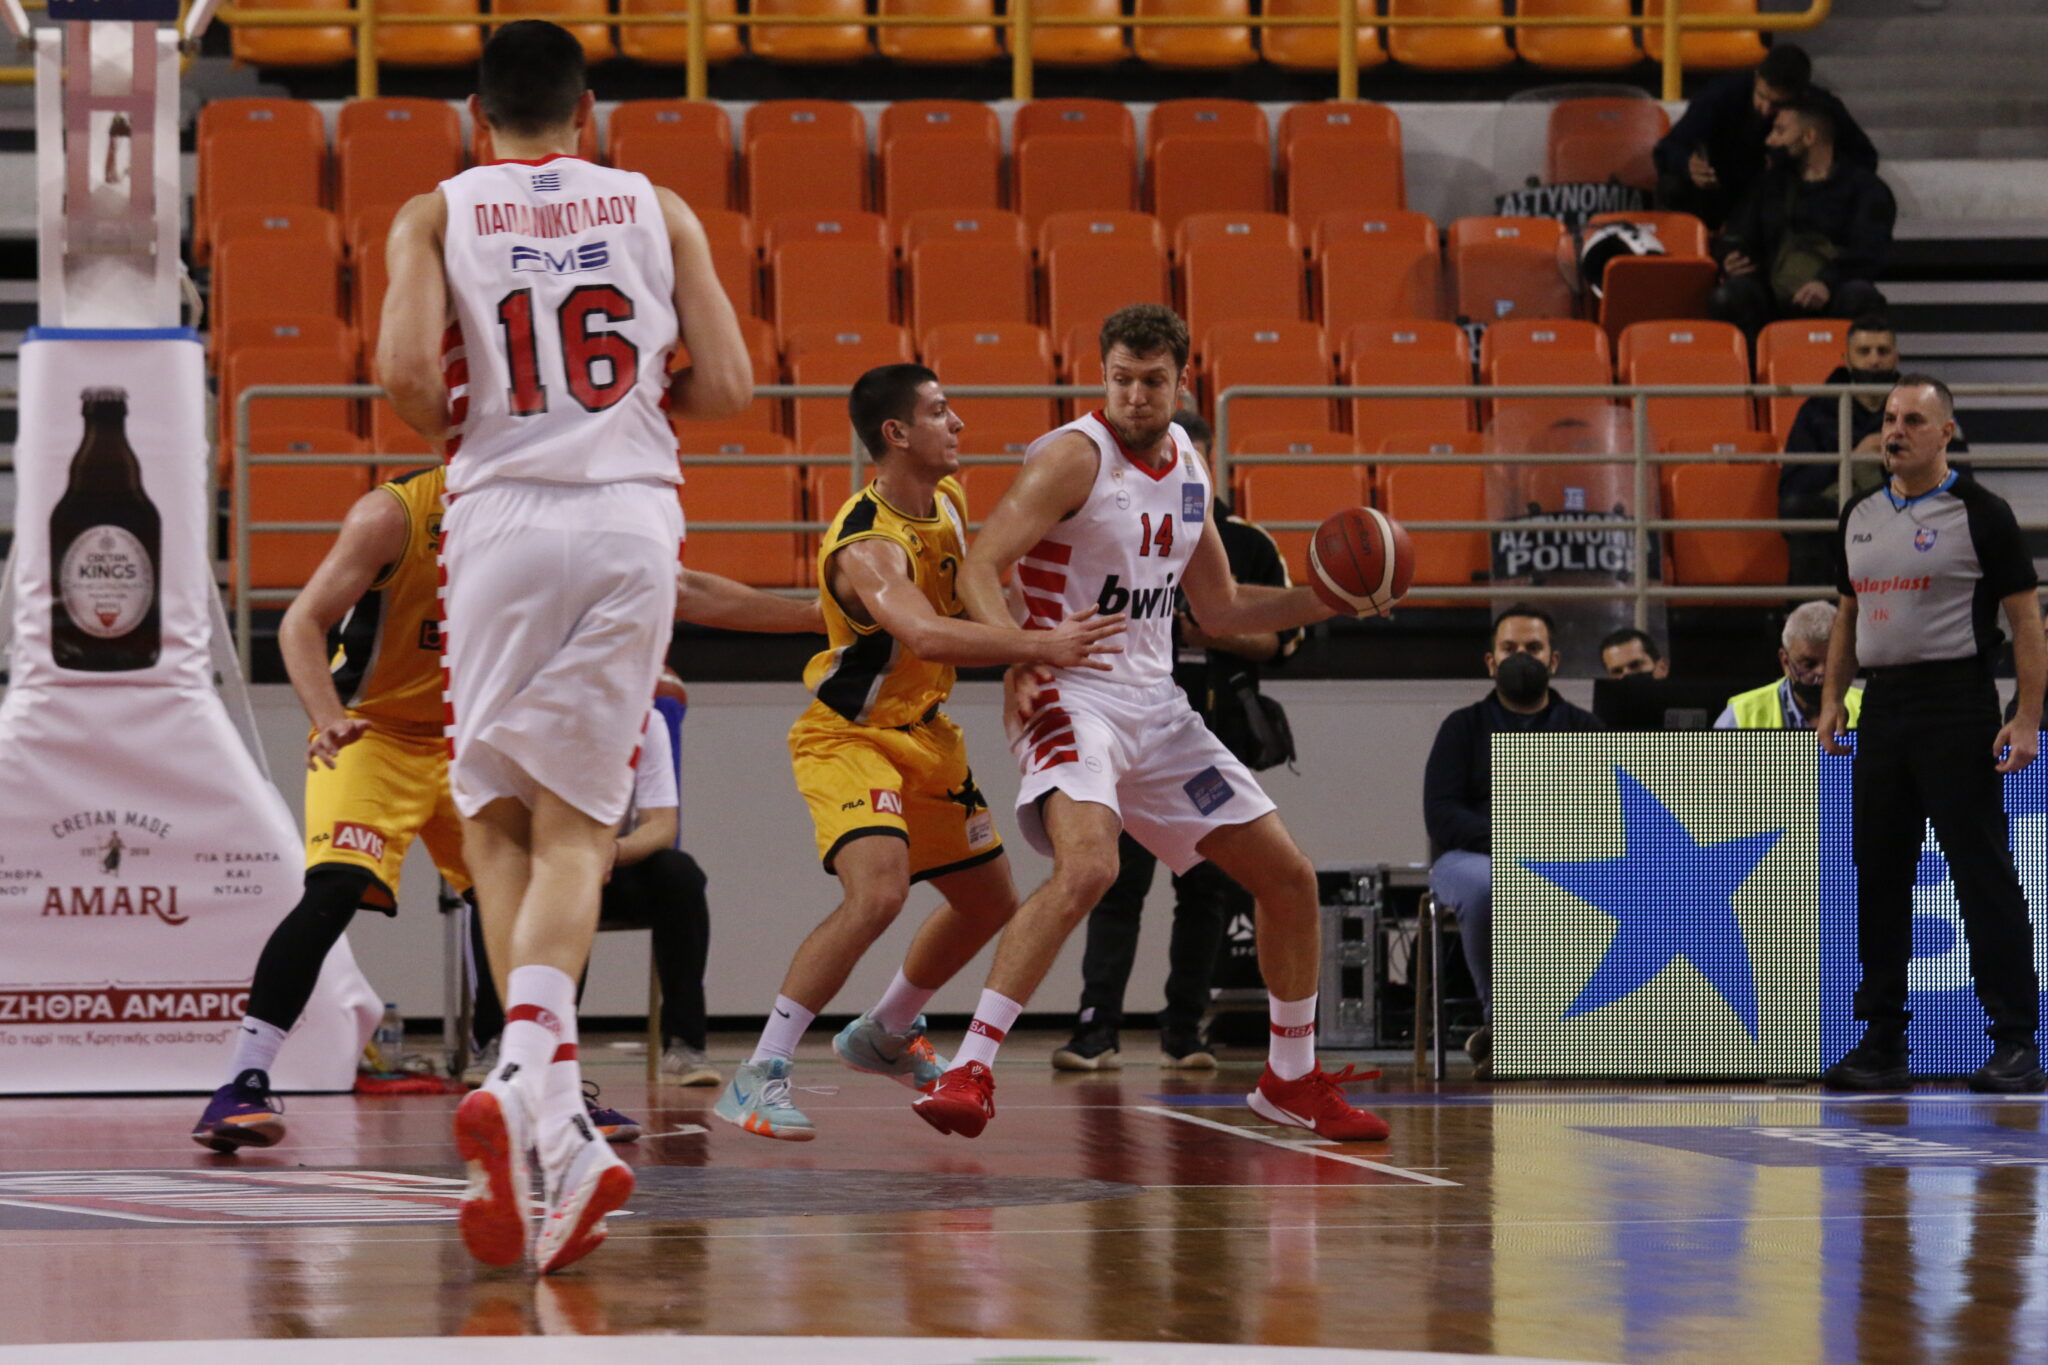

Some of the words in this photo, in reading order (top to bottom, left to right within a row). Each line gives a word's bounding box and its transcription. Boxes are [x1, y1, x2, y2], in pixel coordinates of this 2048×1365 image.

[474, 196, 637, 239] ΠΑΠΑΝΙΚΟΛΑΟΥ
[498, 284, 639, 416] 16
[1139, 512, 1174, 557] 14
[79, 564, 137, 579] KINGS
[1850, 575, 1931, 595] alaplast
[51, 810, 117, 839] CRETAN
[125, 811, 172, 839] MADE
[335, 826, 384, 859] AVIS
[41, 886, 190, 926] AMARI
[121, 993, 250, 1019] ΑΜΑΡΙΟ
